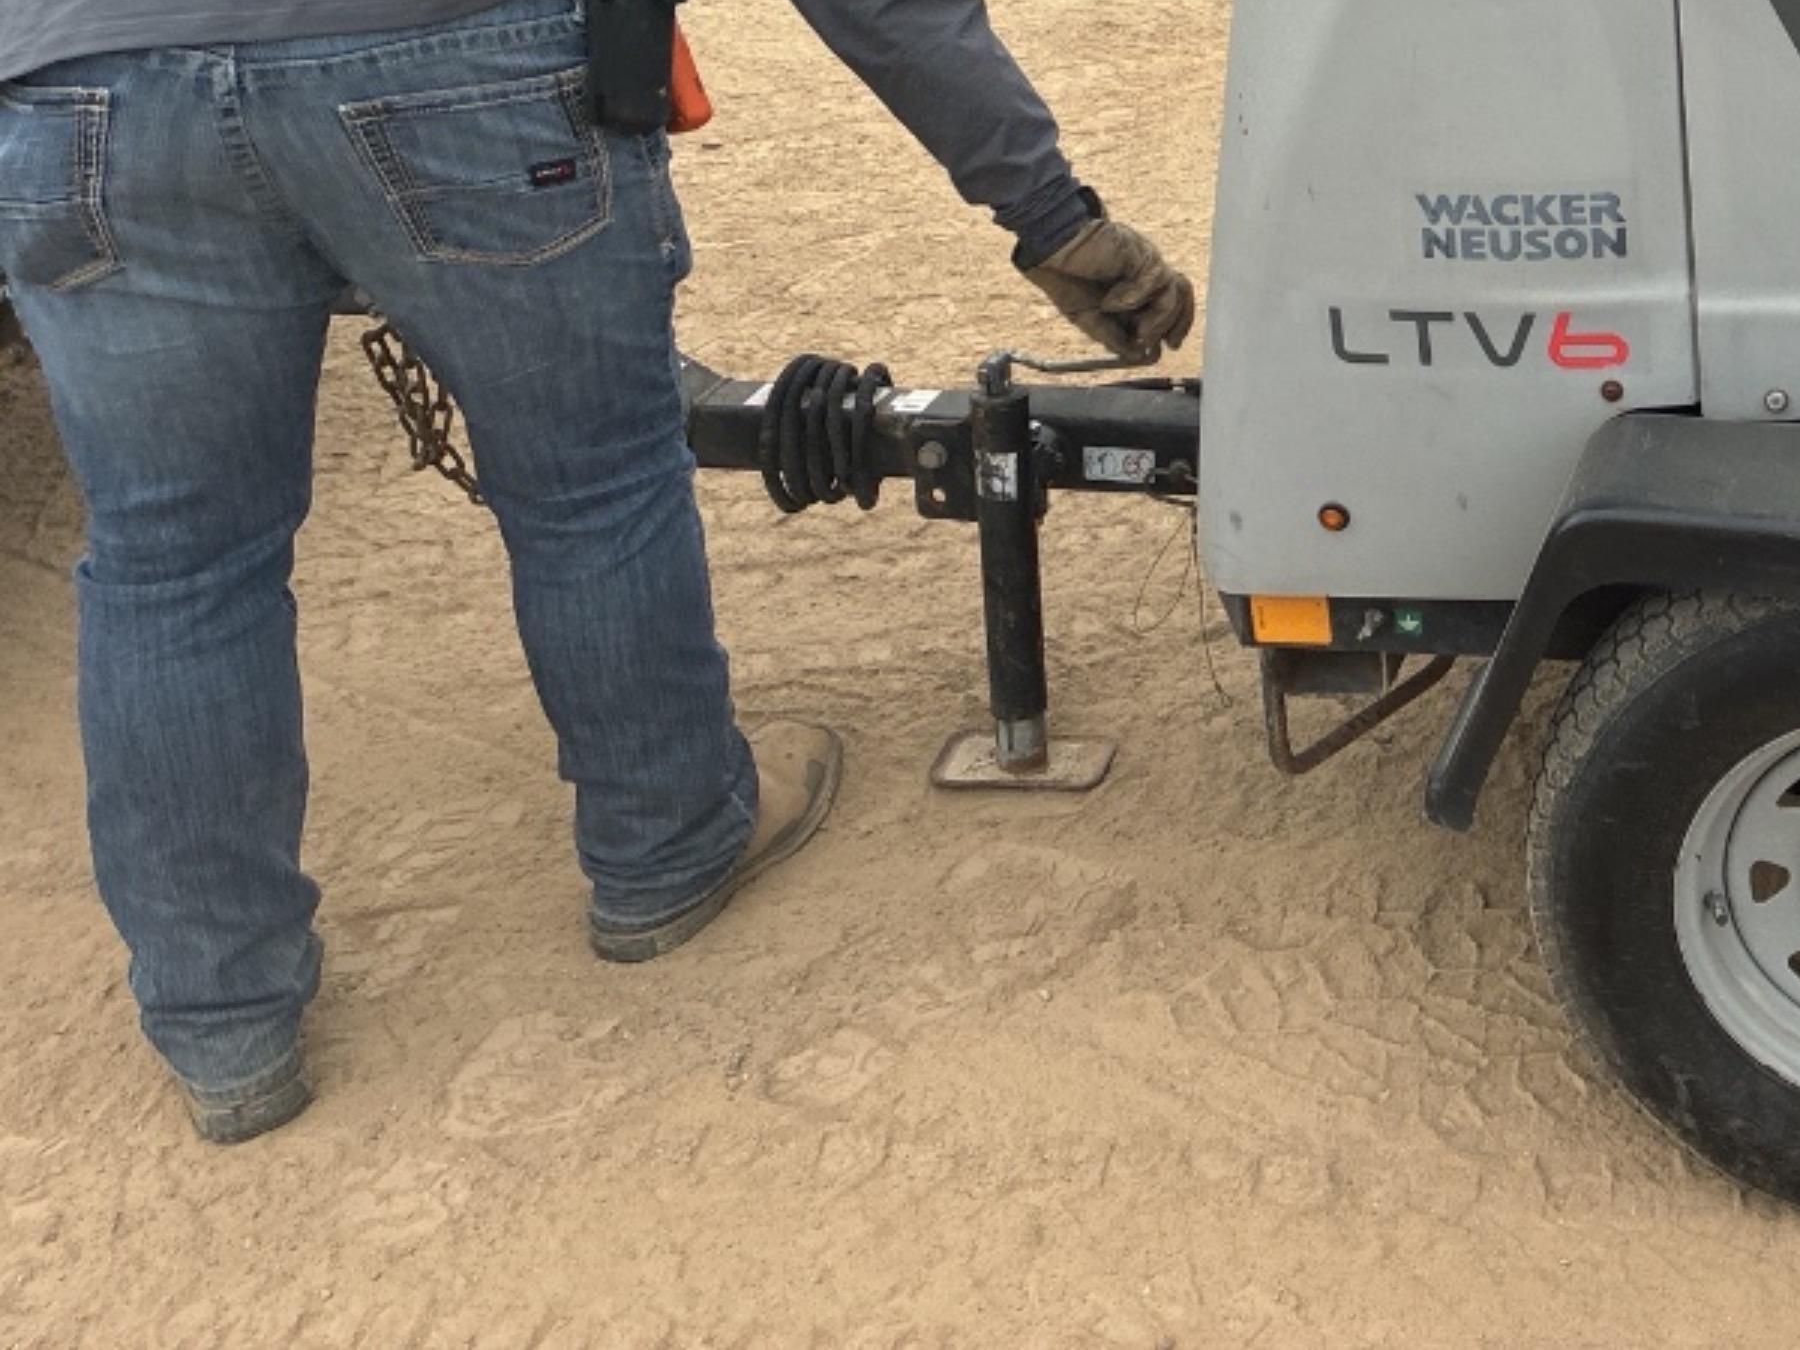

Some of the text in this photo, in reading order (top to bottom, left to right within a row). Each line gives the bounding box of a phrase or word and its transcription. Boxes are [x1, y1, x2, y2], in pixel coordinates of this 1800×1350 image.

[1416, 191, 1627, 226] WACKER
[1421, 227, 1628, 262] NEUSON
[1328, 306, 1630, 369] LTV6
